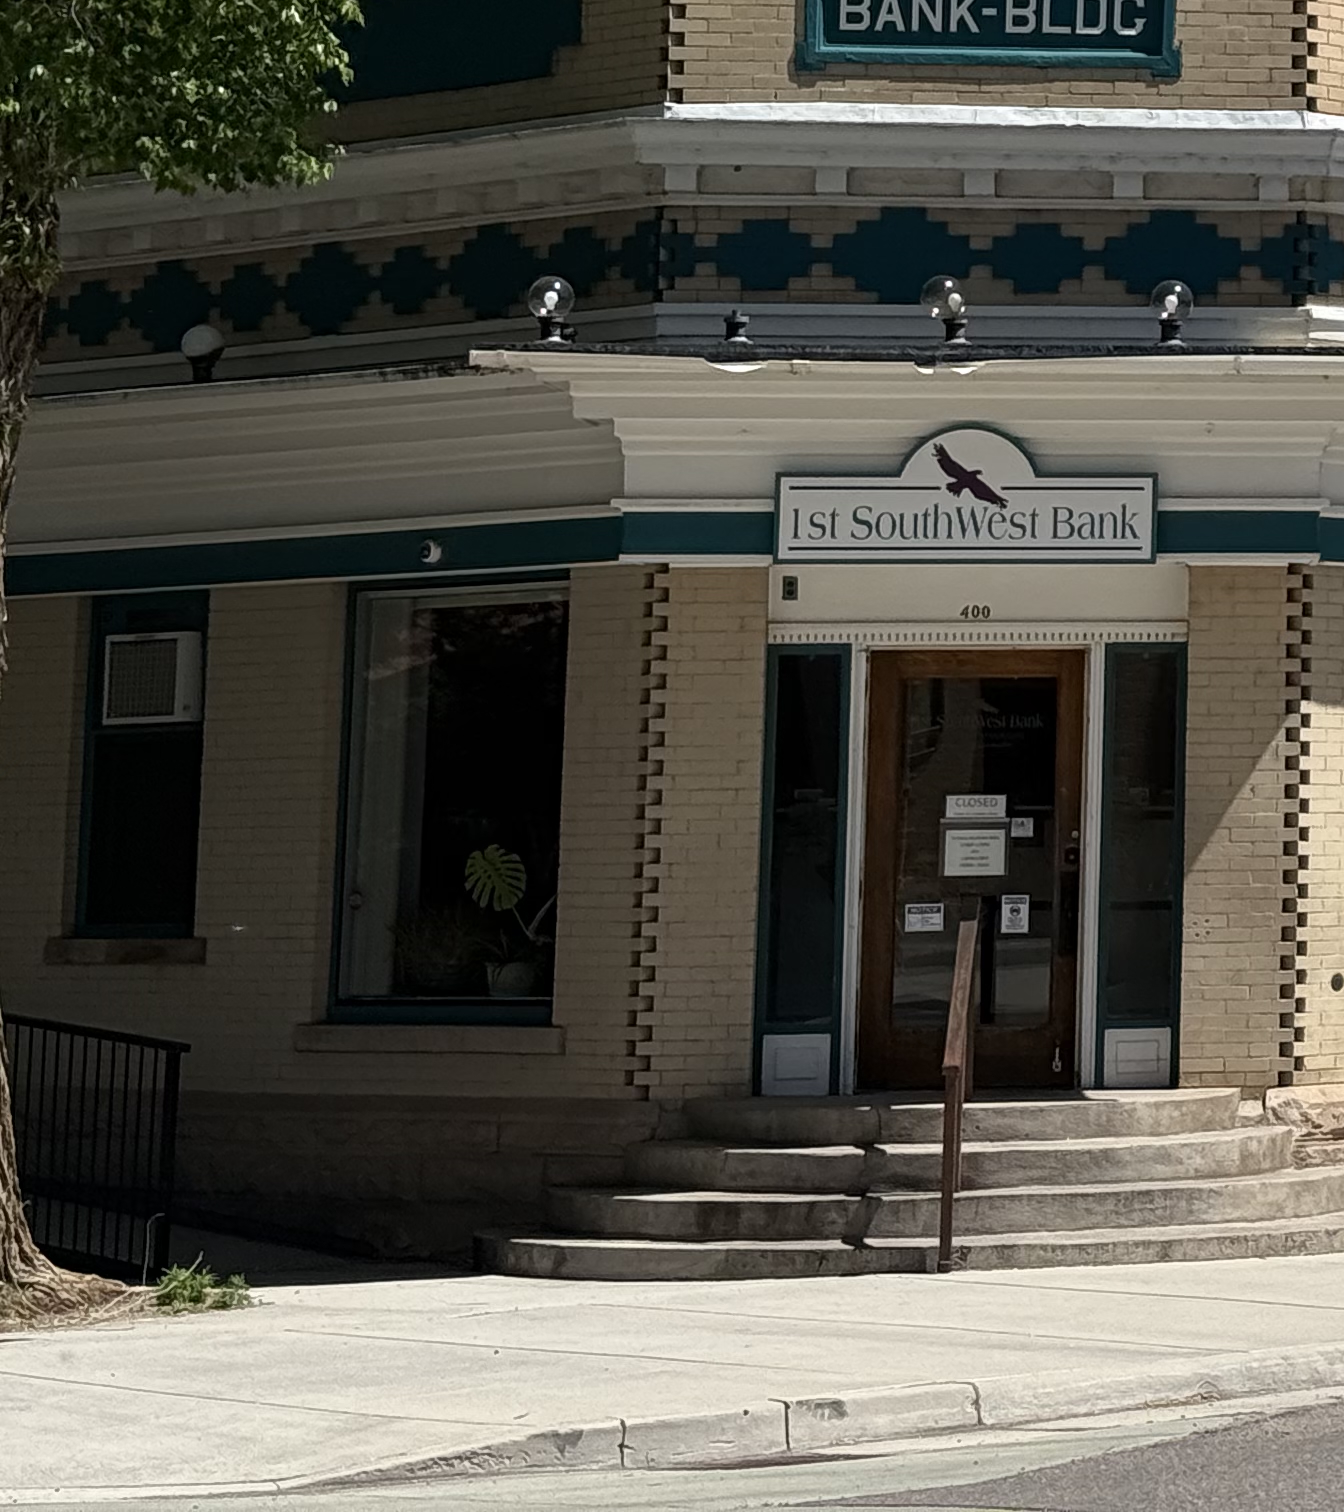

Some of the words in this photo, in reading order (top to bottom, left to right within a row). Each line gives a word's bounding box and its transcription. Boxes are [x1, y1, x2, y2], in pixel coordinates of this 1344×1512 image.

[791, 507, 841, 540] 1st
[849, 502, 1041, 540] SouthWest
[1051, 502, 1141, 540] Bank
[959, 604, 991, 619] 400
[954, 797, 998, 808] CLOSED
